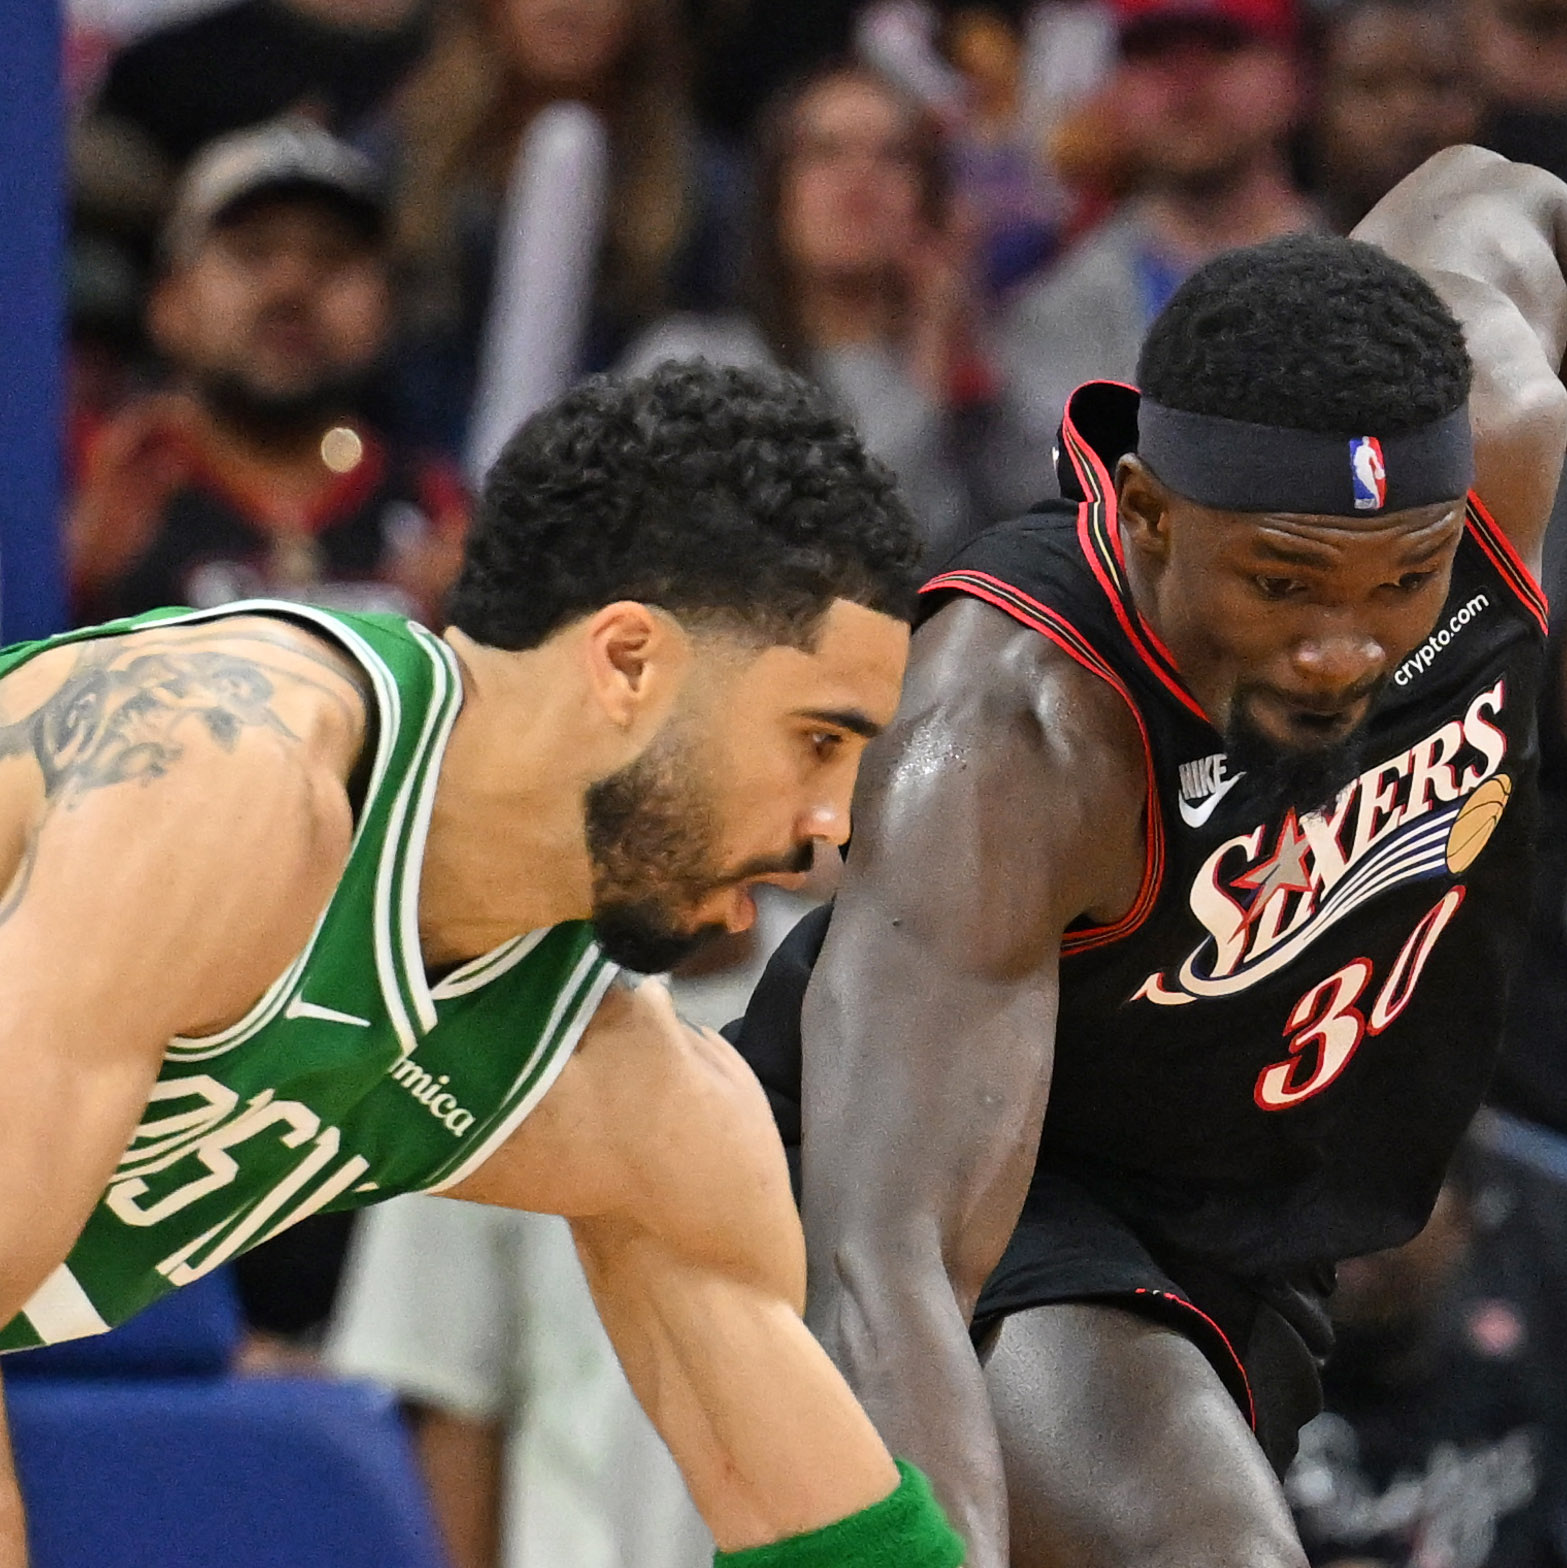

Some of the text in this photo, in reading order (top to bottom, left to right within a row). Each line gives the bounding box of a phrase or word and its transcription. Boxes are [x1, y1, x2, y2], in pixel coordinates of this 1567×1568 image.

[1394, 594, 1490, 686] crypto.com
[1178, 753, 1230, 800] NIKE
[1254, 885, 1466, 1112] 30
[388, 1058, 477, 1138] mica
